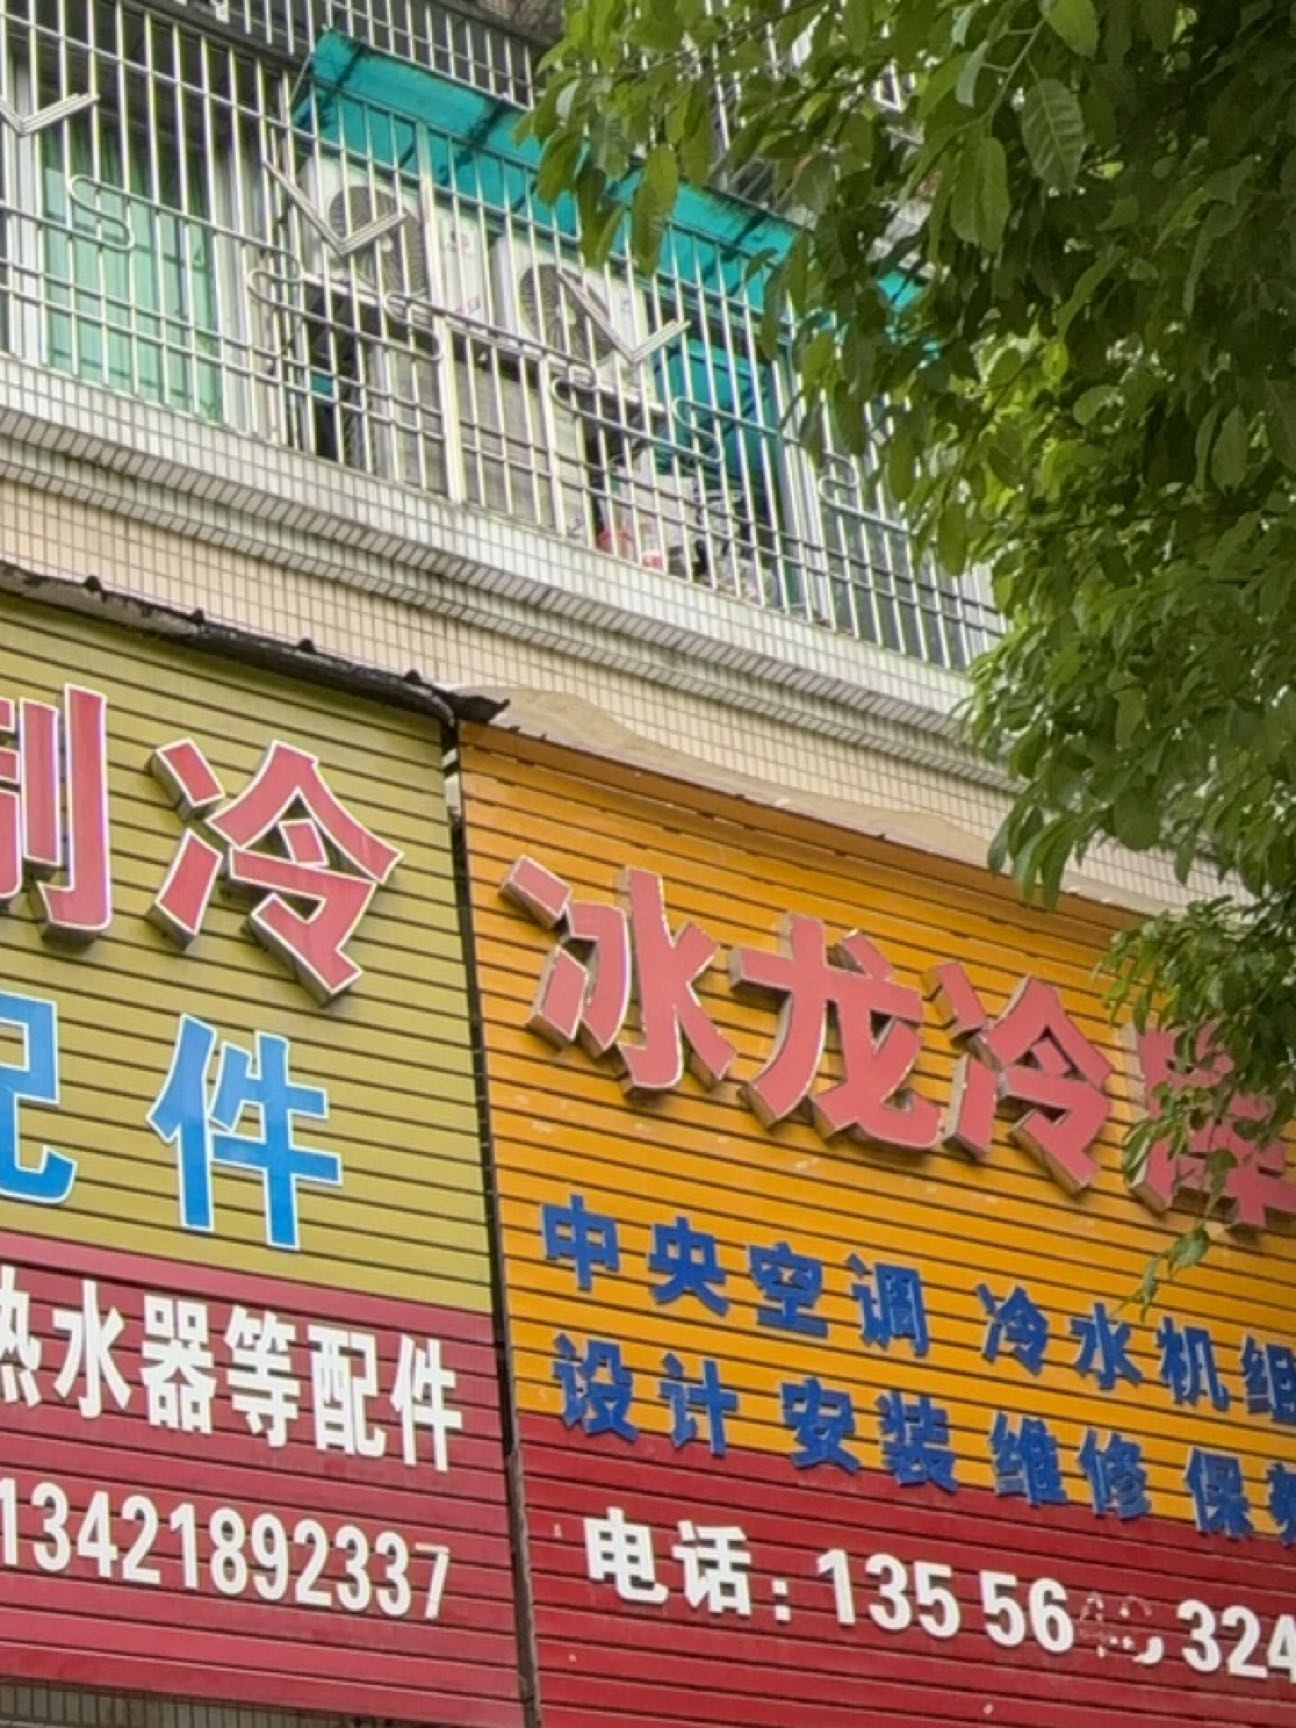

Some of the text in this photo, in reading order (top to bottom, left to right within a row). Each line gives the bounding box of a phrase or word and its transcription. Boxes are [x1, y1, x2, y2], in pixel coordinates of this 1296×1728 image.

[541, 1194, 1296, 1426] 中央空调 冷水机组
[552, 1333, 739, 1458] 设计
[780, 1375, 958, 1495] 安装
[989, 1409, 1152, 1521] 维修
